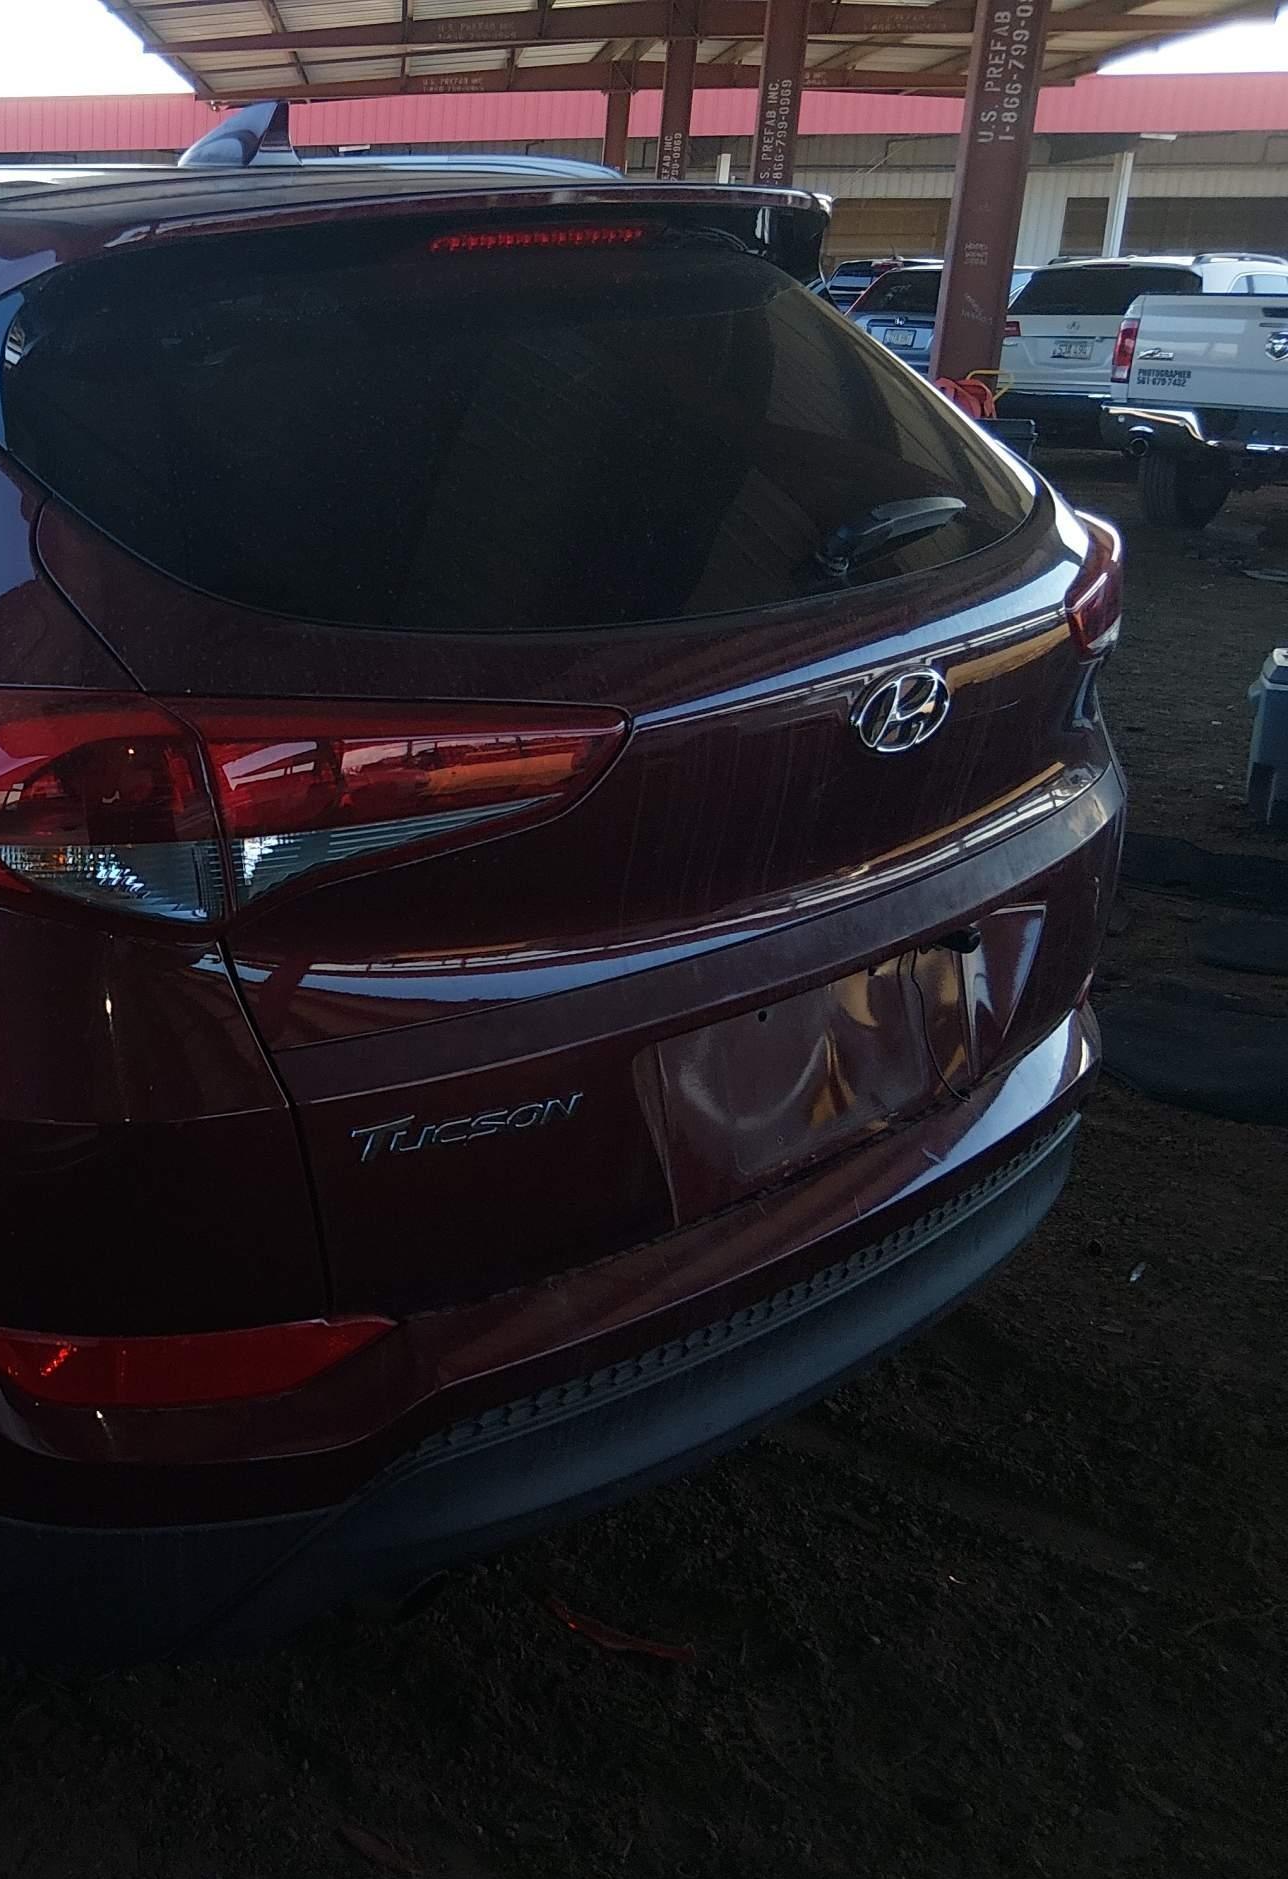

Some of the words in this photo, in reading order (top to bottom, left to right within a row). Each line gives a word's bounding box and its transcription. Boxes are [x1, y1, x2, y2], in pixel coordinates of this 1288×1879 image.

[984, 11, 1011, 92] PREFAB
[998, 0, 1034, 141] 1-866-799-0
[768, 79, 781, 108] INC.
[978, 104, 1000, 143] U.S.
[762, 110, 777, 161] PREFAB
[772, 79, 792, 185] -866-799-0969
[351, 1091, 584, 1162] TUCSON
